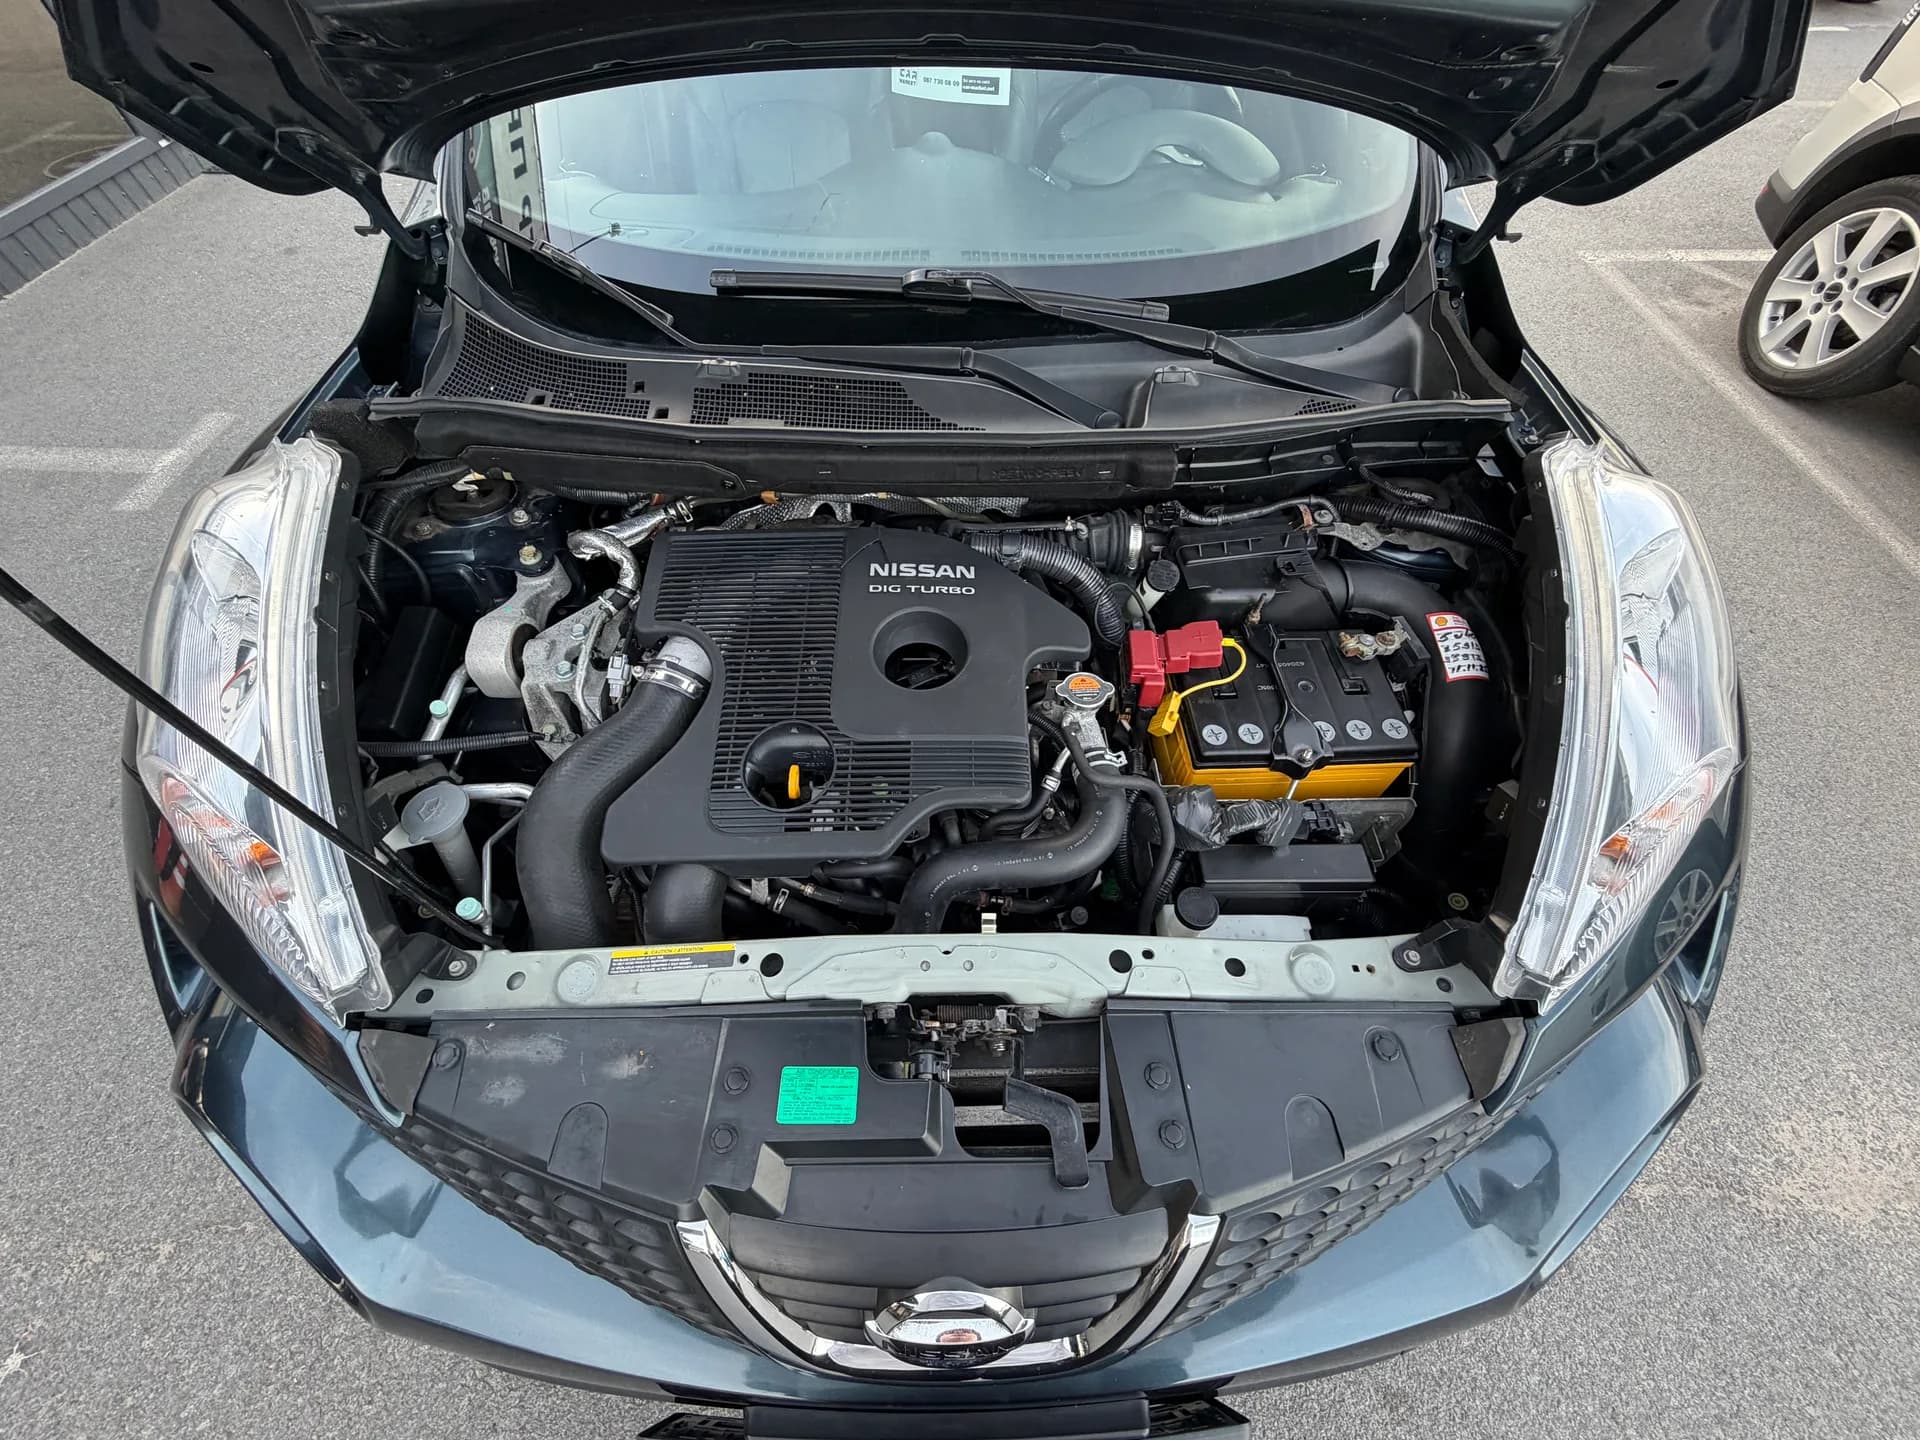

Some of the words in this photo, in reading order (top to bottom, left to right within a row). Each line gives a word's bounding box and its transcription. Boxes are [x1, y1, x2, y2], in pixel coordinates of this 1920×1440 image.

[899, 69, 918, 80] CAR
[869, 562, 976, 579] NISSAN
[869, 584, 901, 593] DIG
[906, 585, 976, 595] TURBO
